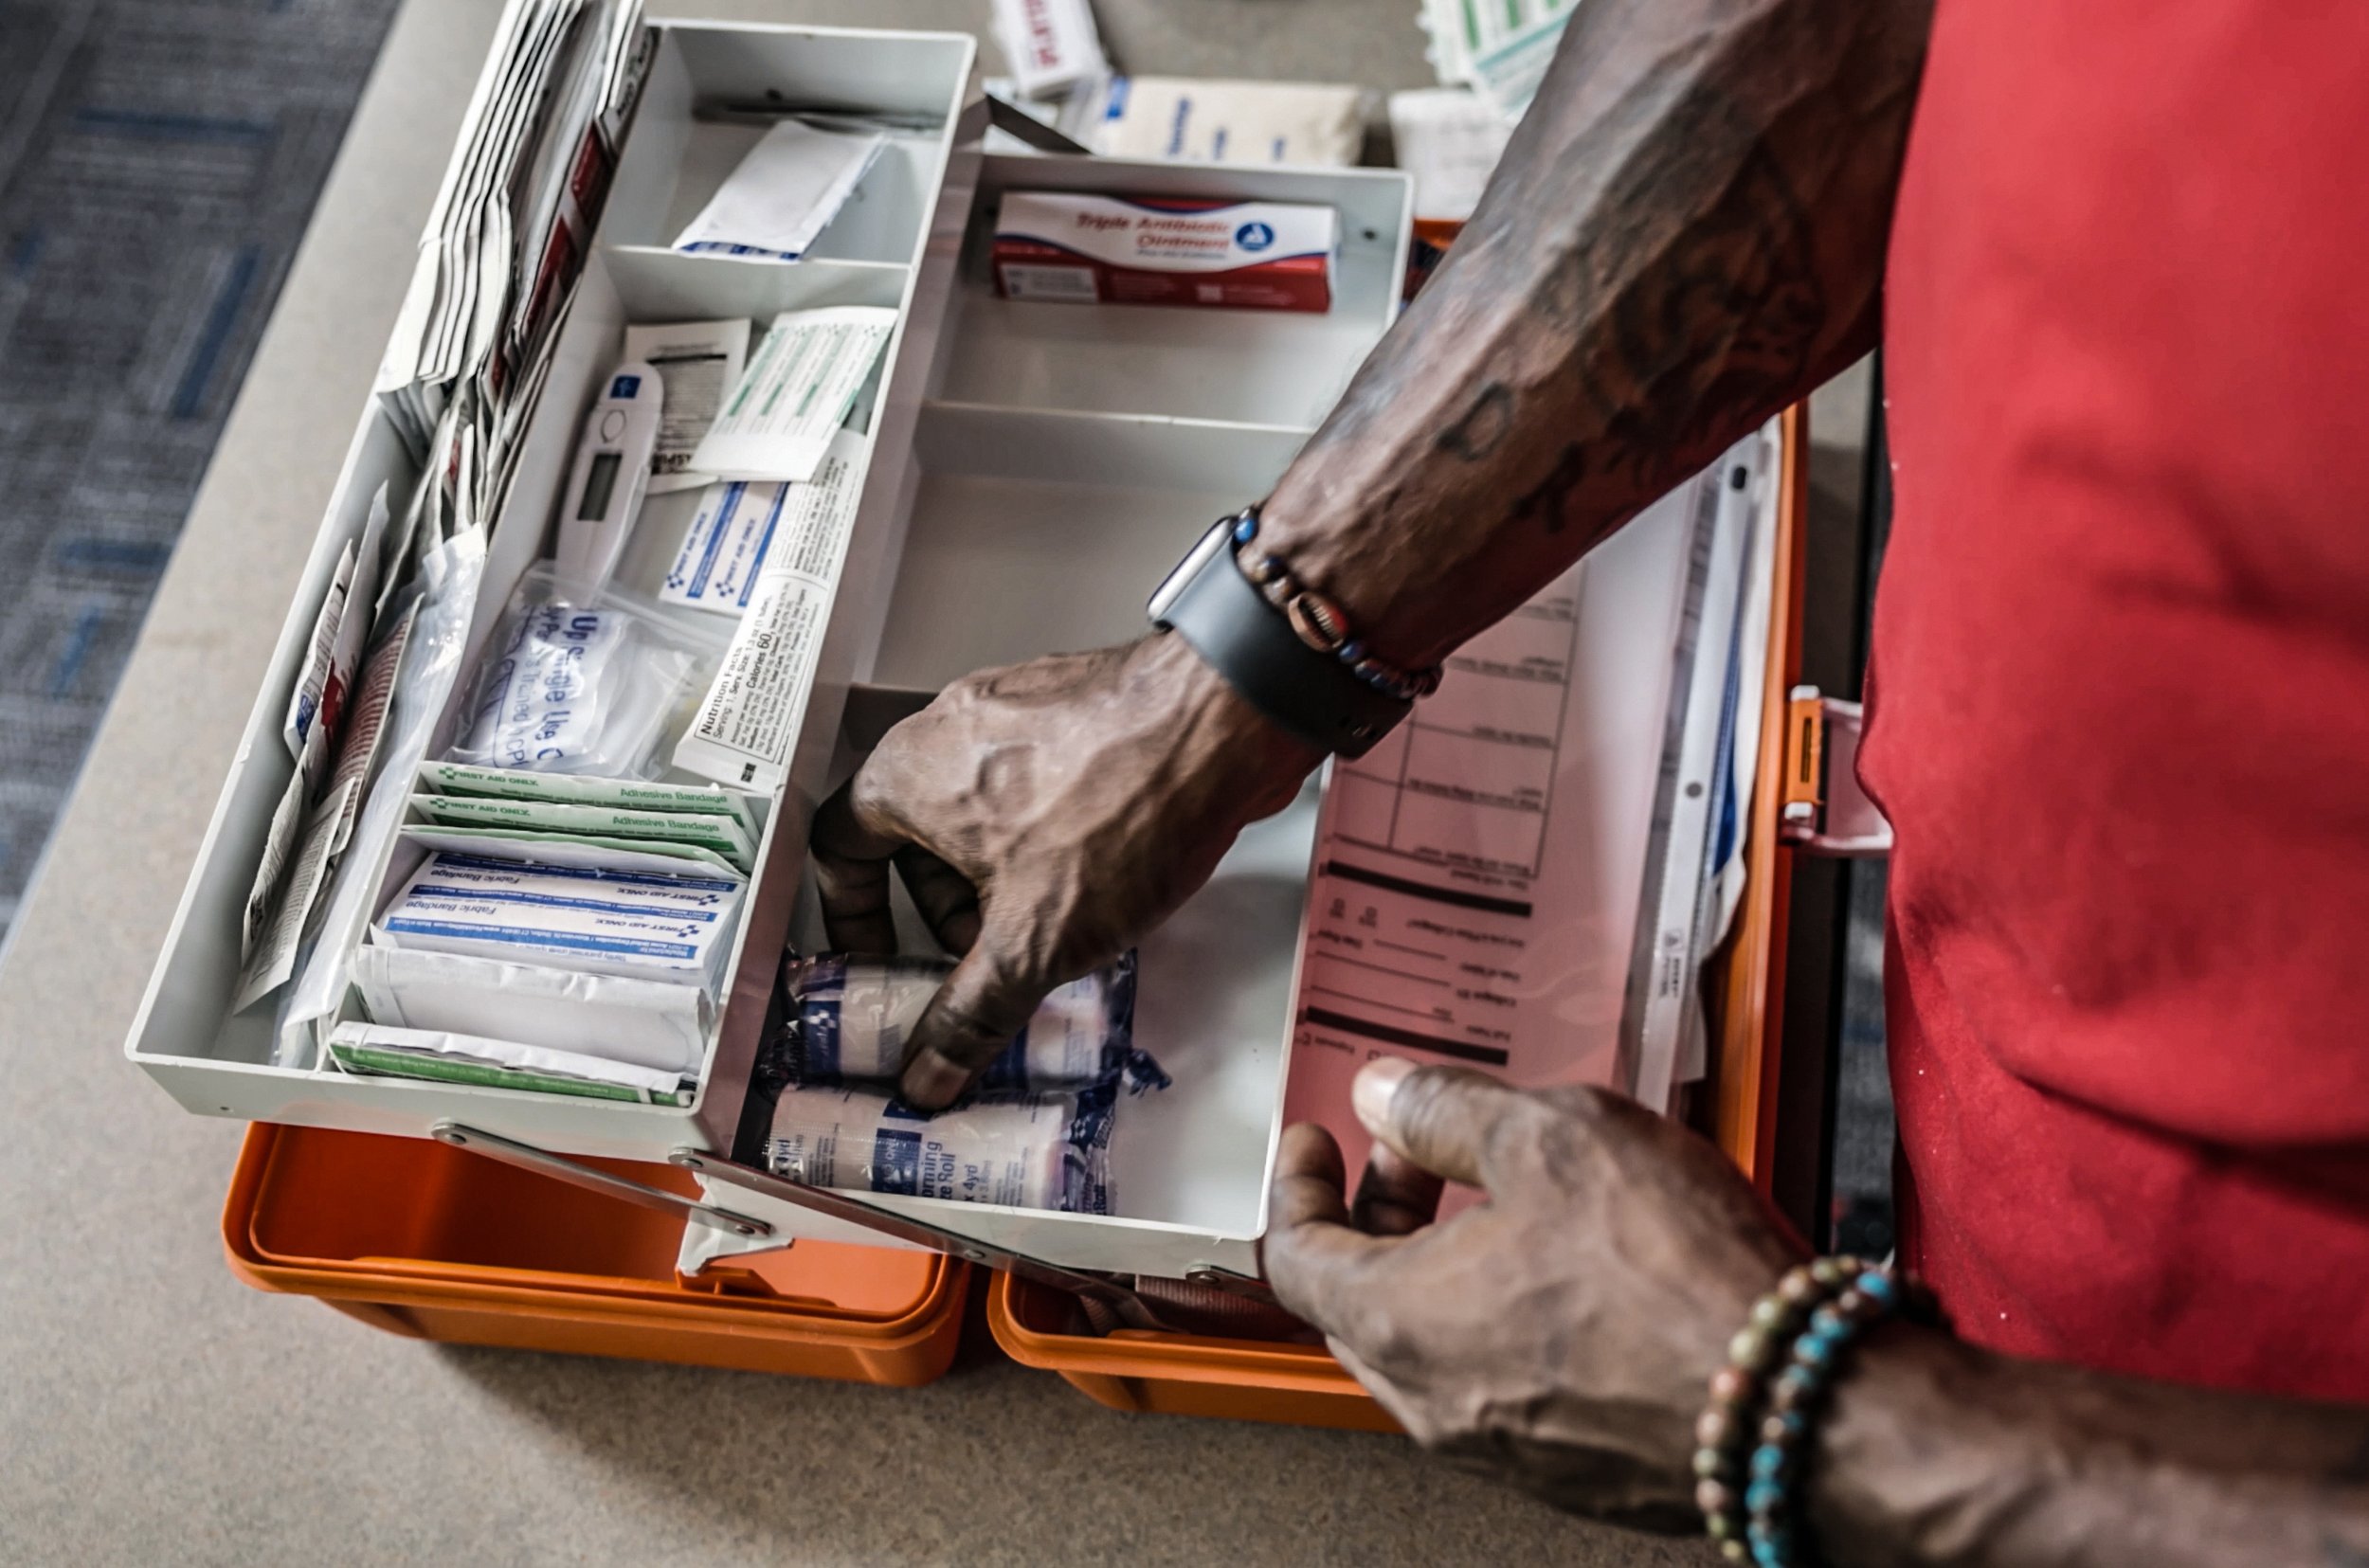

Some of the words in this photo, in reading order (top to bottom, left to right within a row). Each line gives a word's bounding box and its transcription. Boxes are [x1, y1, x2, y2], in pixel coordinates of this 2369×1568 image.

[1076, 212, 1131, 230] Triple
[1136, 217, 1229, 233] Antibiotic
[1137, 234, 1229, 248] Ointment
[746, 652, 766, 688] Calories
[700, 681, 727, 734] Nutrition
[724, 647, 742, 676] Facts
[621, 788, 673, 800] Adhesive
[676, 791, 727, 802] Bandage
[612, 816, 665, 827] Adhesive
[668, 820, 719, 832] Bandage
[430, 868, 481, 880] Bandage
[483, 874, 521, 884] Fabric
[405, 901, 457, 910] Bandage
[460, 904, 497, 914] Fabric
[936, 1153, 954, 1181] Roll
[963, 1165, 979, 1190] 4yd
